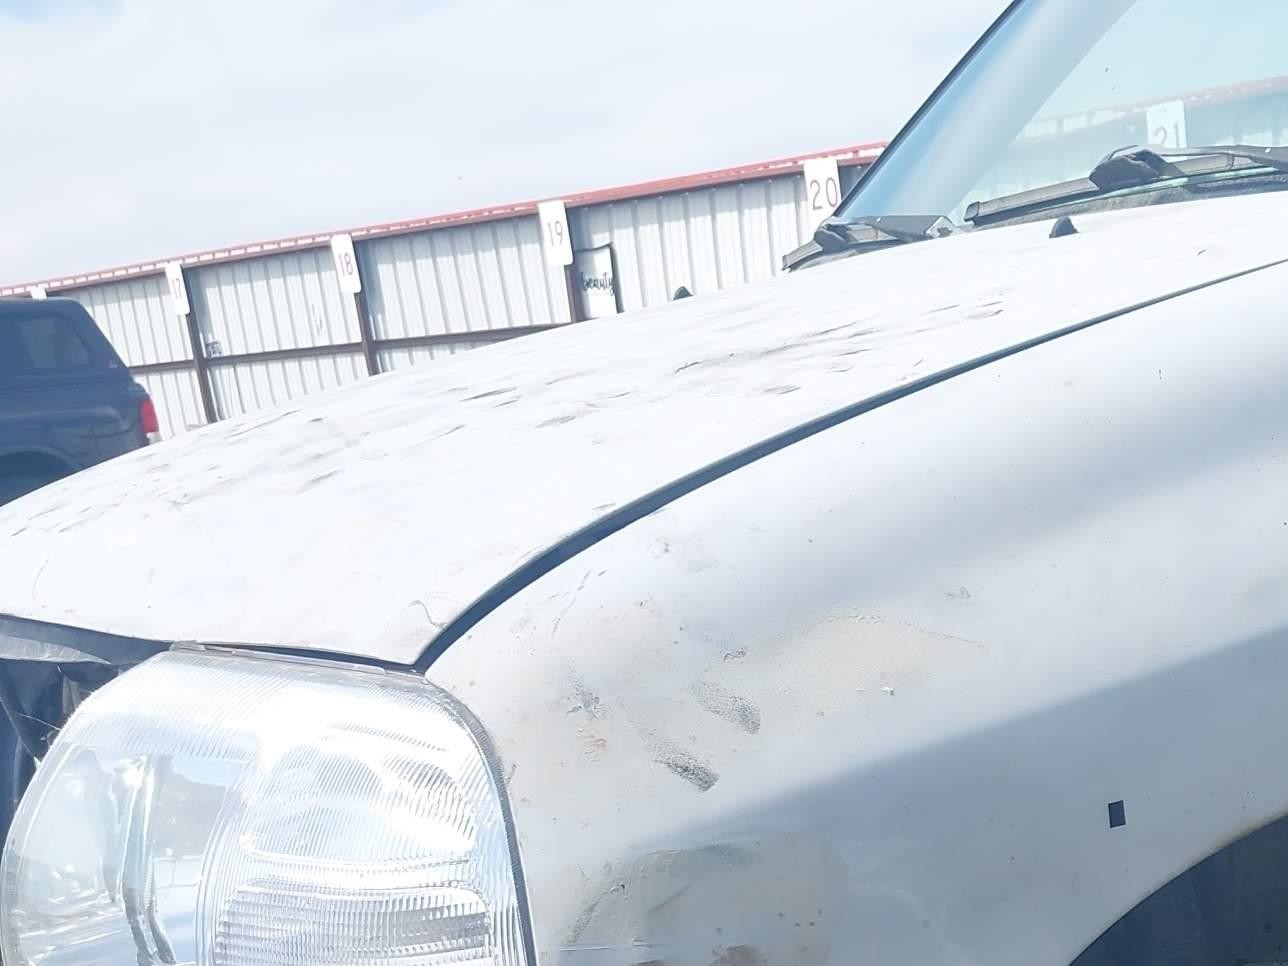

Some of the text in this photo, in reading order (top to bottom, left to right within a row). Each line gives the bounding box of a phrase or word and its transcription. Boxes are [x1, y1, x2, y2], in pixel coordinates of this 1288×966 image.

[809, 176, 838, 211] 20
[547, 220, 564, 247] 19
[338, 252, 354, 277] 18
